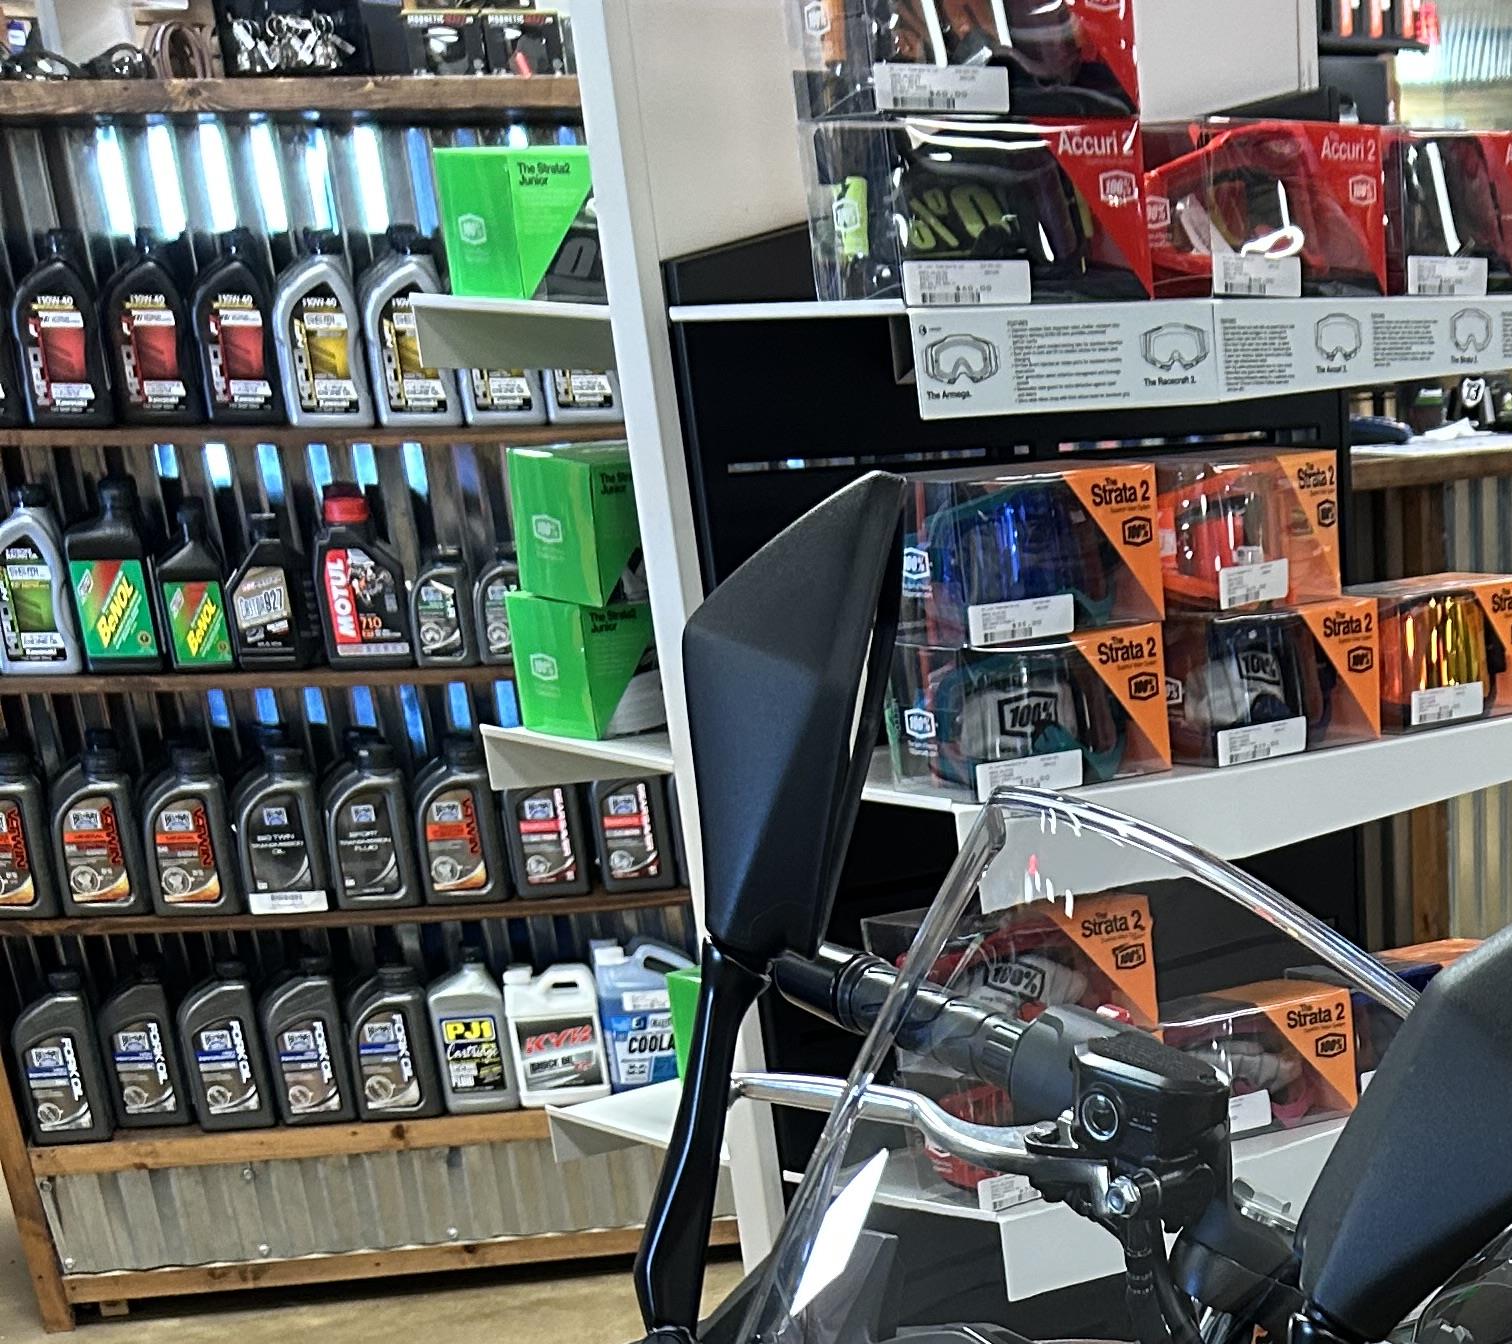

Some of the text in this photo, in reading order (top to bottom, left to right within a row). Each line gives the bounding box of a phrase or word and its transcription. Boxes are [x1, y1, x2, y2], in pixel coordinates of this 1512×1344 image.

[1058, 131, 1135, 156] Accuri 2
[1321, 136, 1376, 161] Accuri 2
[517, 162, 535, 174] The
[519, 175, 548, 186] Junior
[926, 391, 940, 400] The
[1328, 465, 1335, 485] 2
[1091, 480, 1150, 507] Strata 2
[1127, 523, 1149, 540] 100%
[263, 588, 286, 611] 927
[326, 558, 357, 638] MOTUL
[360, 615, 383, 629] 710
[1323, 613, 1373, 638] Strata 2
[1097, 637, 1157, 665] Strata 2
[1133, 678, 1156, 694] 100%
[1081, 910, 1145, 938] Strata 2
[1119, 949, 1143, 965] 100%
[992, 966, 1038, 996] 100%
[1287, 1002, 1345, 1029] Strata 2
[446, 1020, 494, 1040] PJ1
[628, 1033, 676, 1054] COOLA
[1320, 1038, 1343, 1053] 100%
